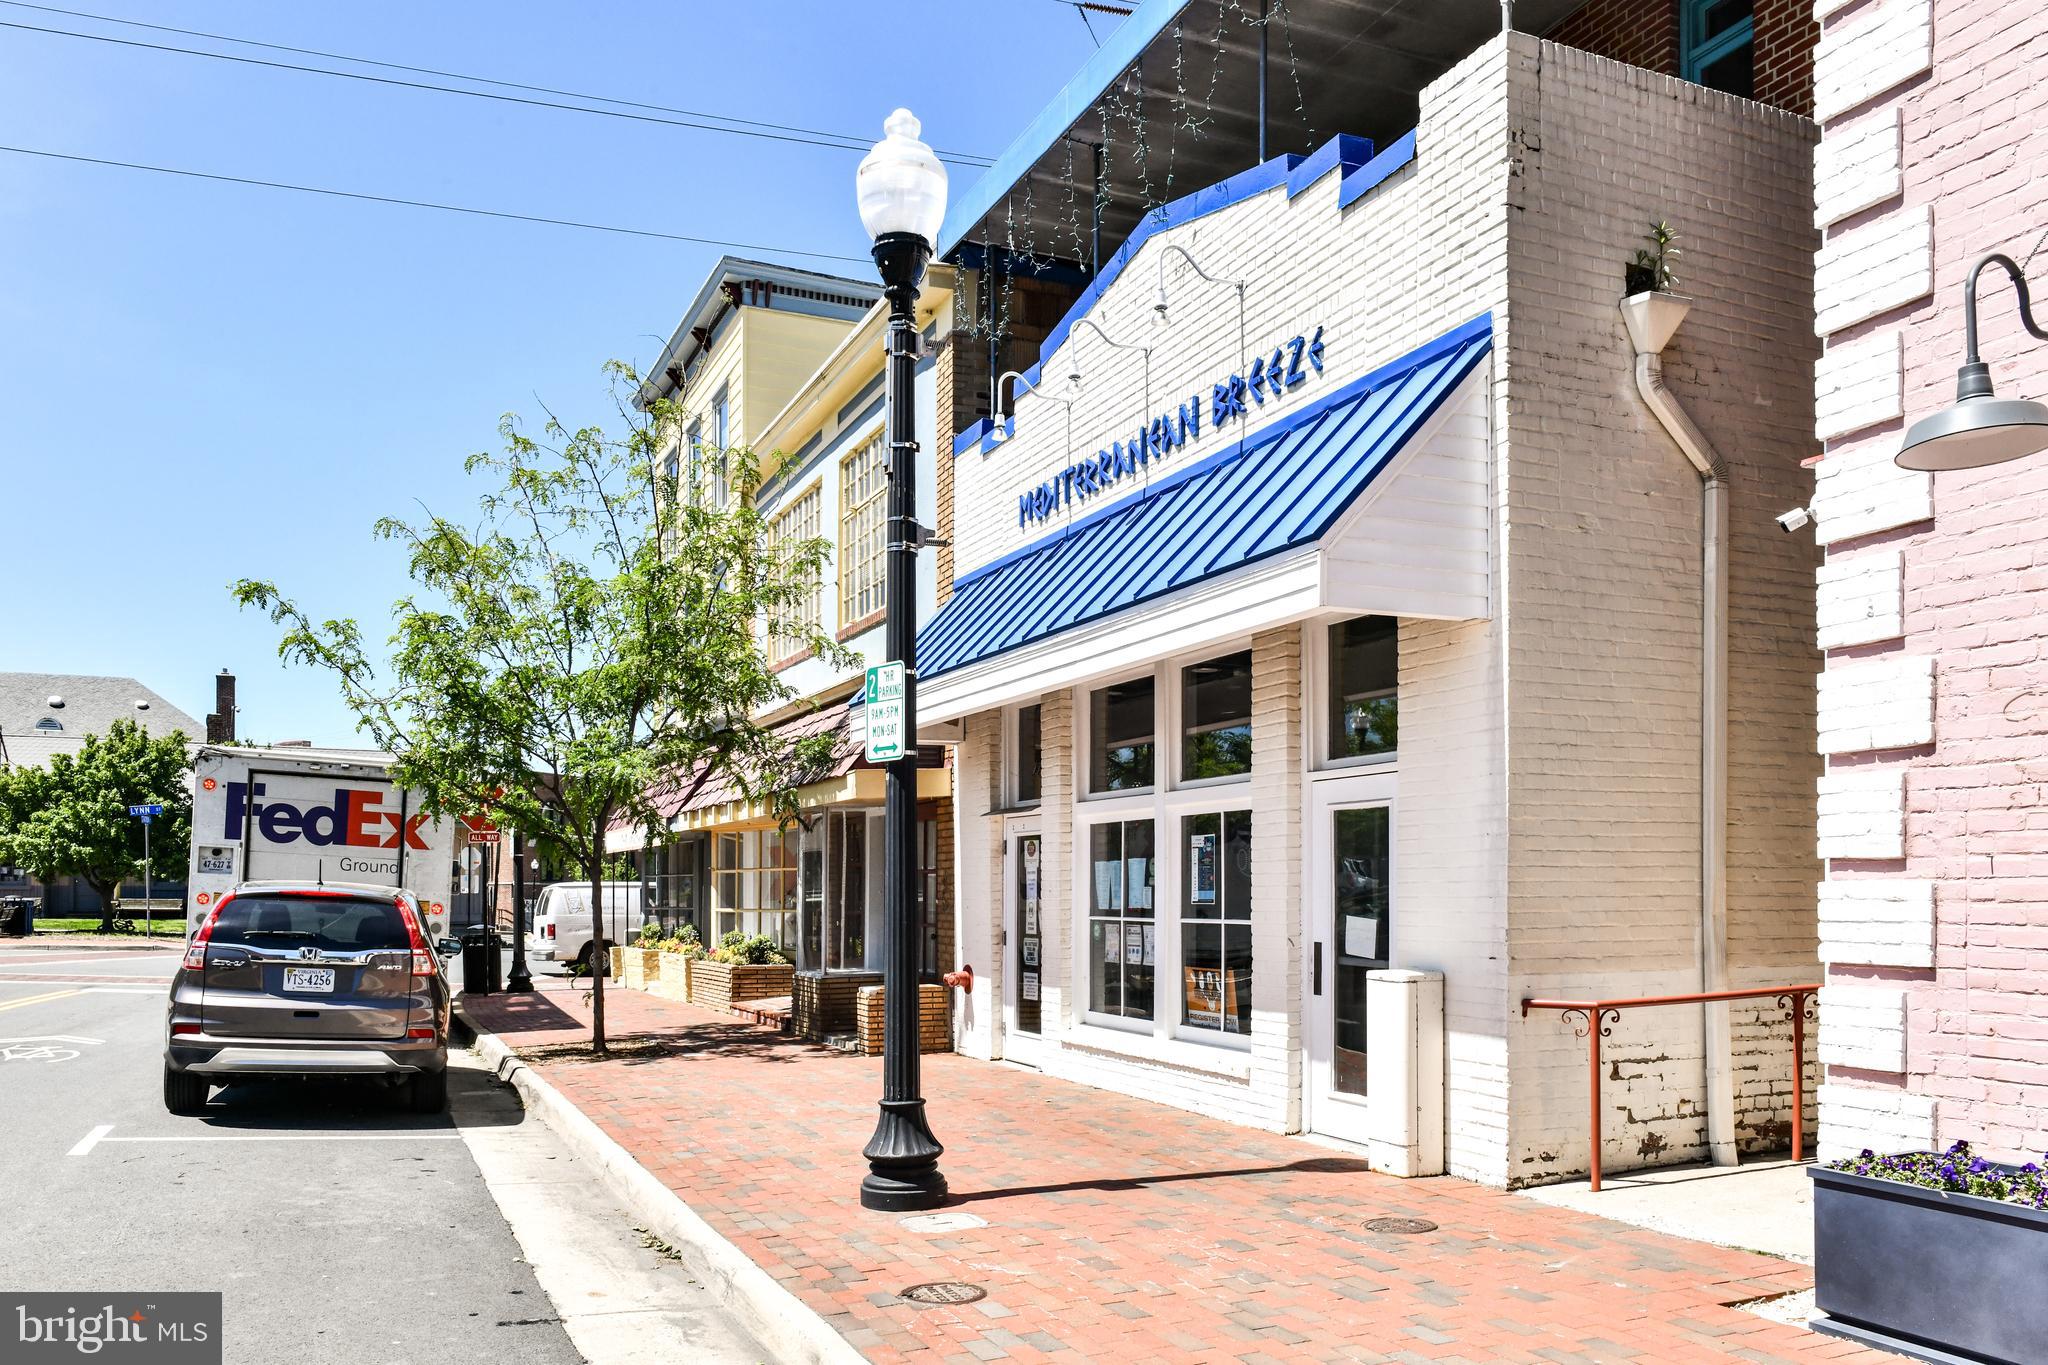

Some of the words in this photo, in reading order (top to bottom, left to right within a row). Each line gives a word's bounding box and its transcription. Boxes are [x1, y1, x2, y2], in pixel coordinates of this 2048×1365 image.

[1019, 395, 1200, 528] MEDITERRANEAN
[1212, 325, 1325, 427] BREEZE
[869, 675, 876, 698] 2
[878, 683, 902, 699] PARKING
[871, 704, 899, 720] 9AM-5PM
[872, 723, 897, 738] MON-SAT
[130, 806, 150, 815] LYNN
[224, 781, 432, 850] FedEx
[340, 857, 399, 874] Ground
[286, 973, 331, 986] VTS-4256
[1189, 1013, 1221, 1025] REGISTER
